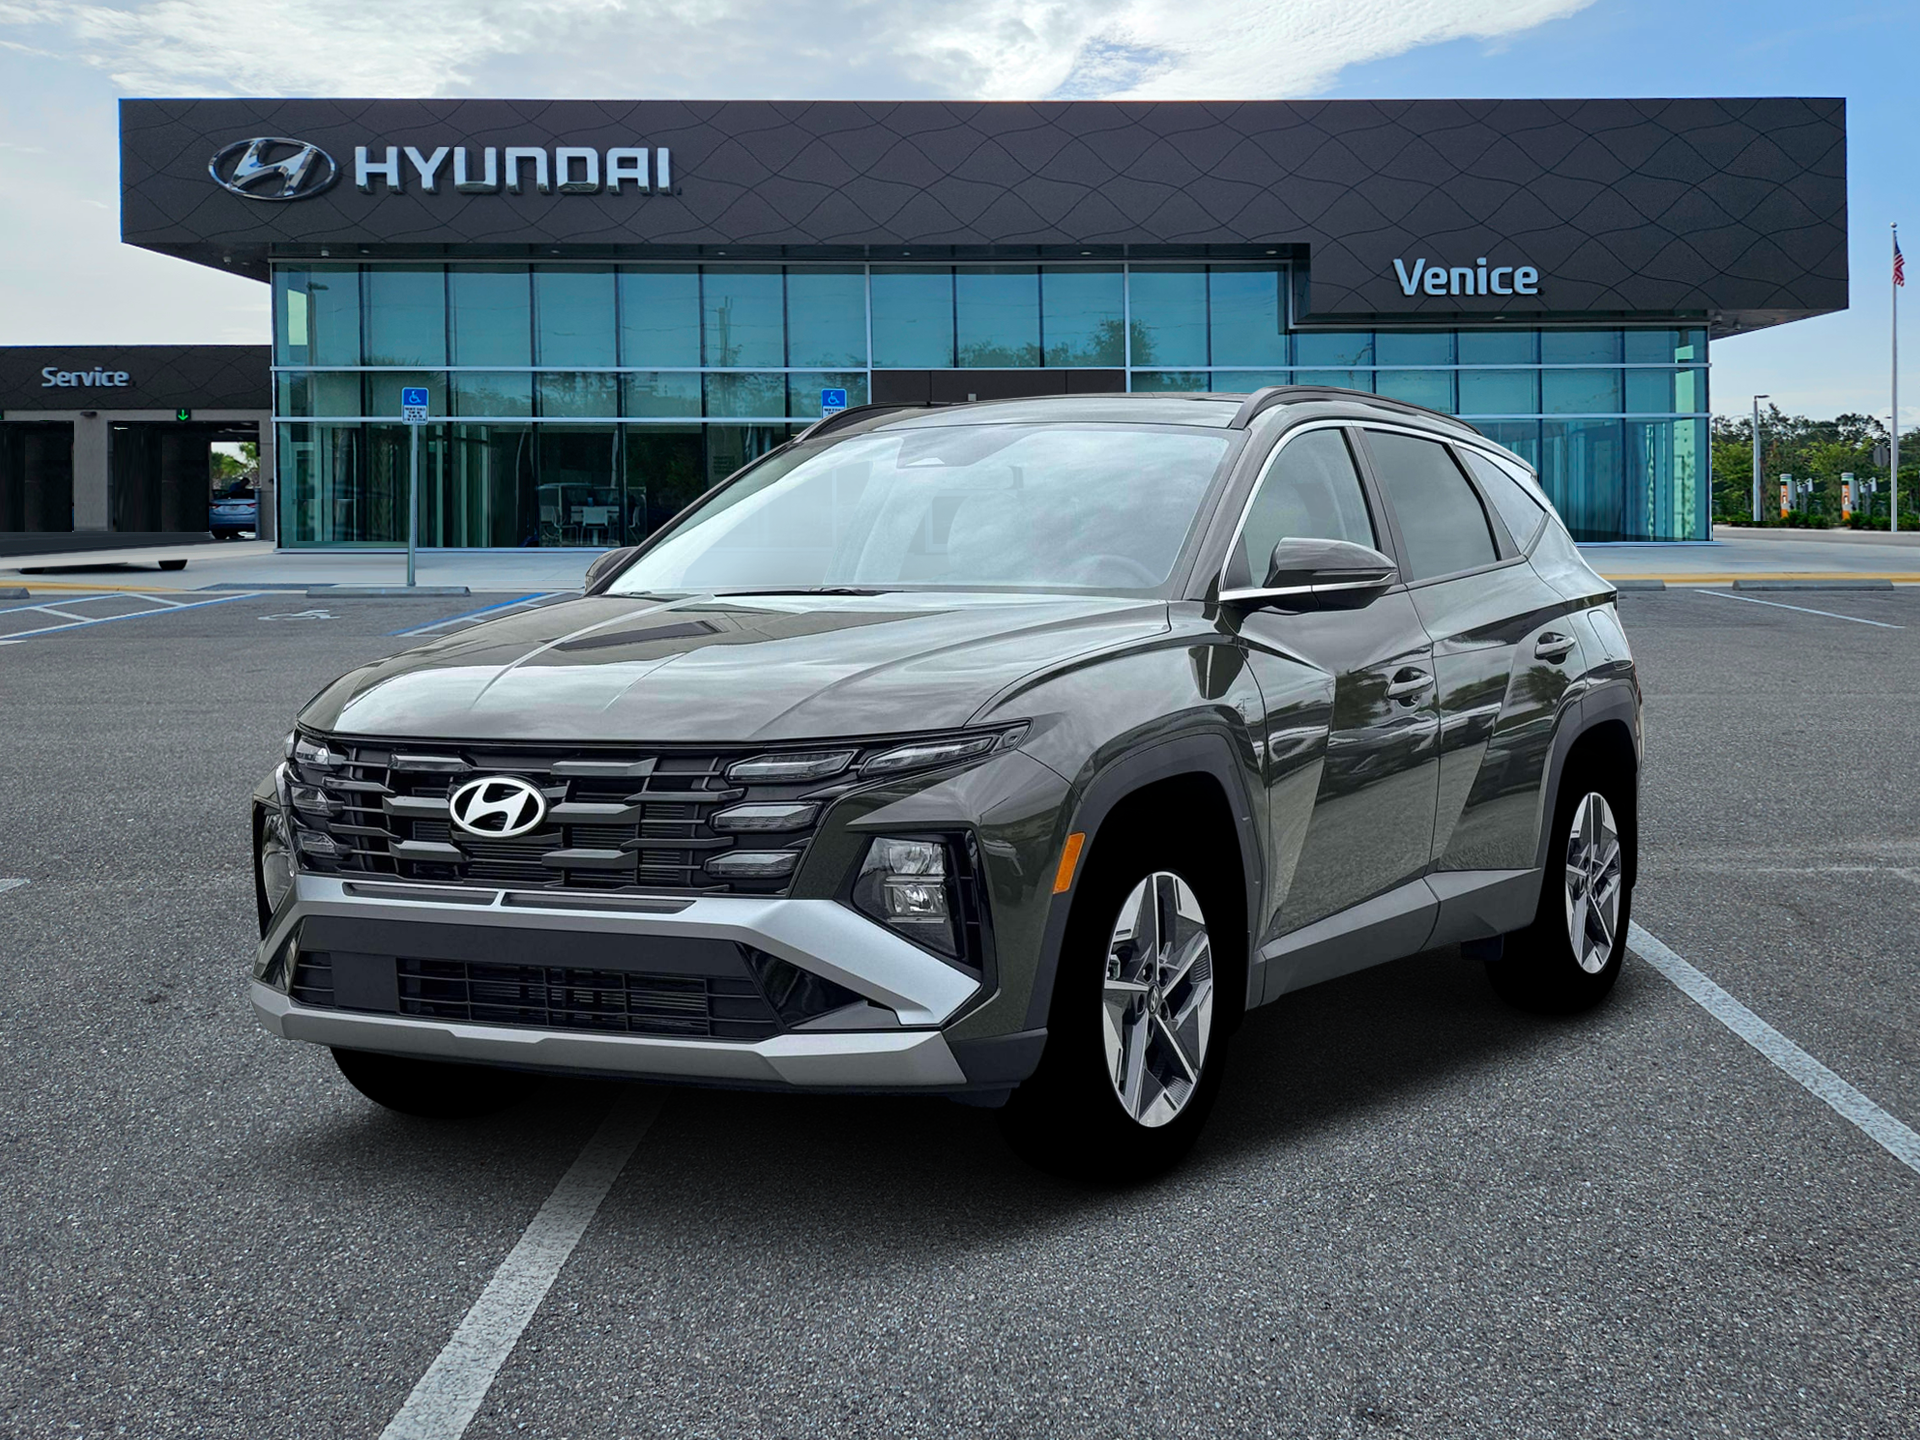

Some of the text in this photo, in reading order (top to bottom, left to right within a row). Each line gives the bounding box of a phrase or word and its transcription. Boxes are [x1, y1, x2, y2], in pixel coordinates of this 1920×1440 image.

[355, 146, 670, 193] HYUNDAI
[1393, 257, 1539, 296] Venice
[41, 366, 130, 387] Service
